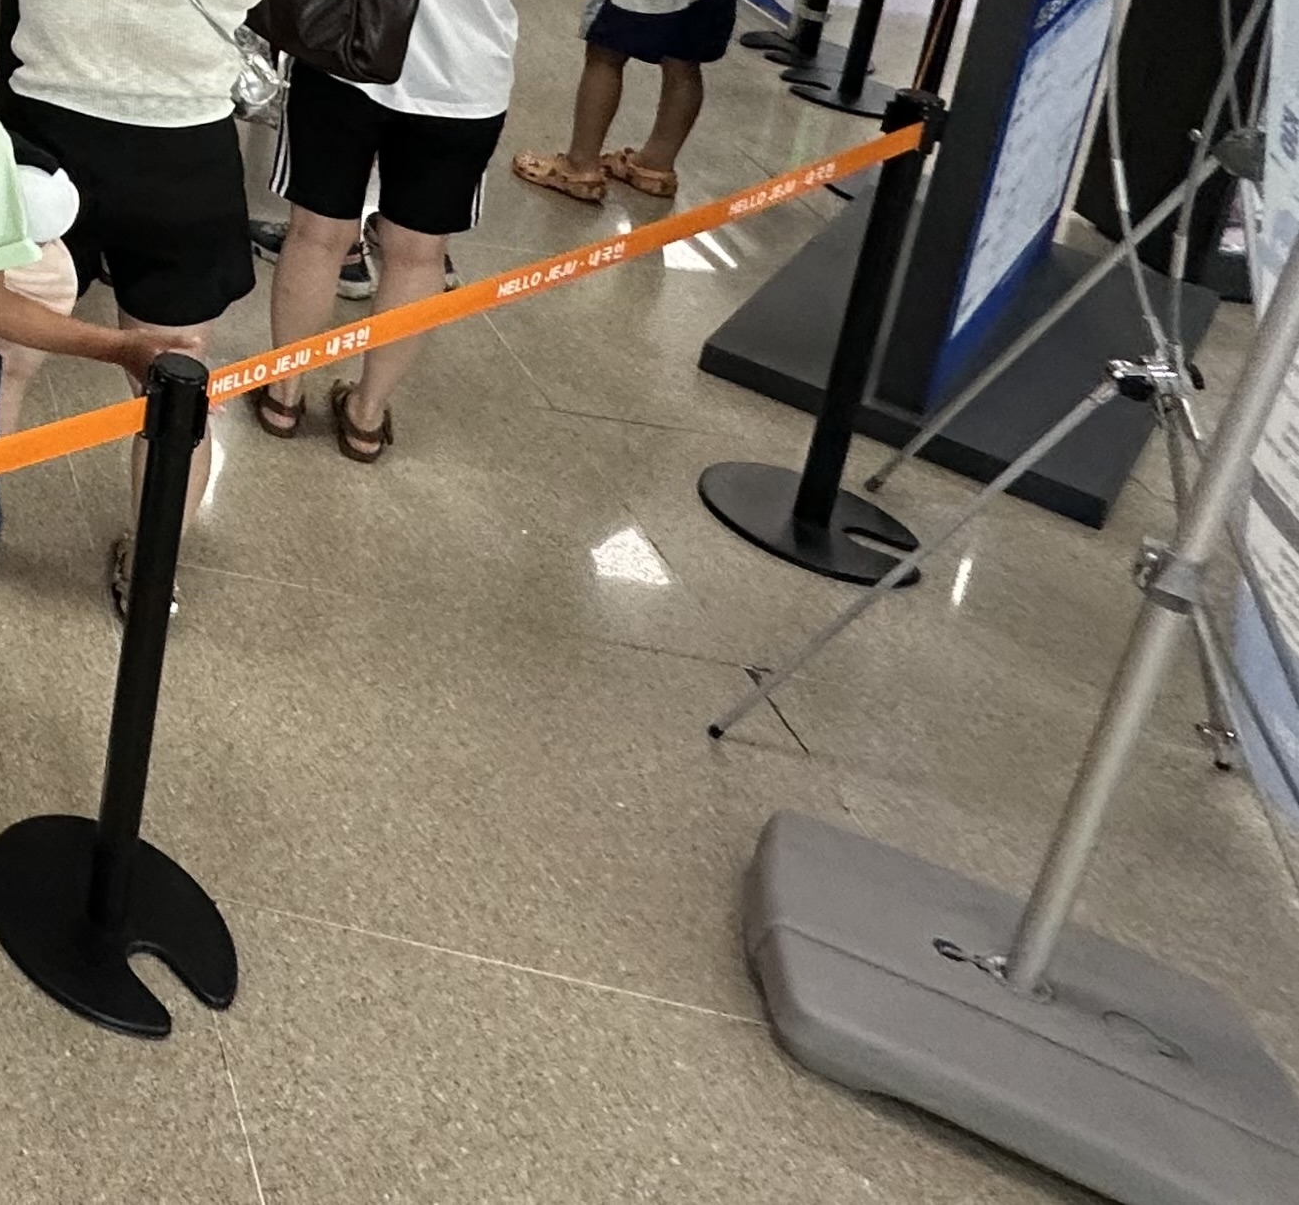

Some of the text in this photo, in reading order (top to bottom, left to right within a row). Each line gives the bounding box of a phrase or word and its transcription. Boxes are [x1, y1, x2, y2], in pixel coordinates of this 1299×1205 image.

[498, 272, 541, 297] HELLO
[545, 261, 577, 282] JEJU
[212, 327, 369, 395] HELLO JEJU 내국인
